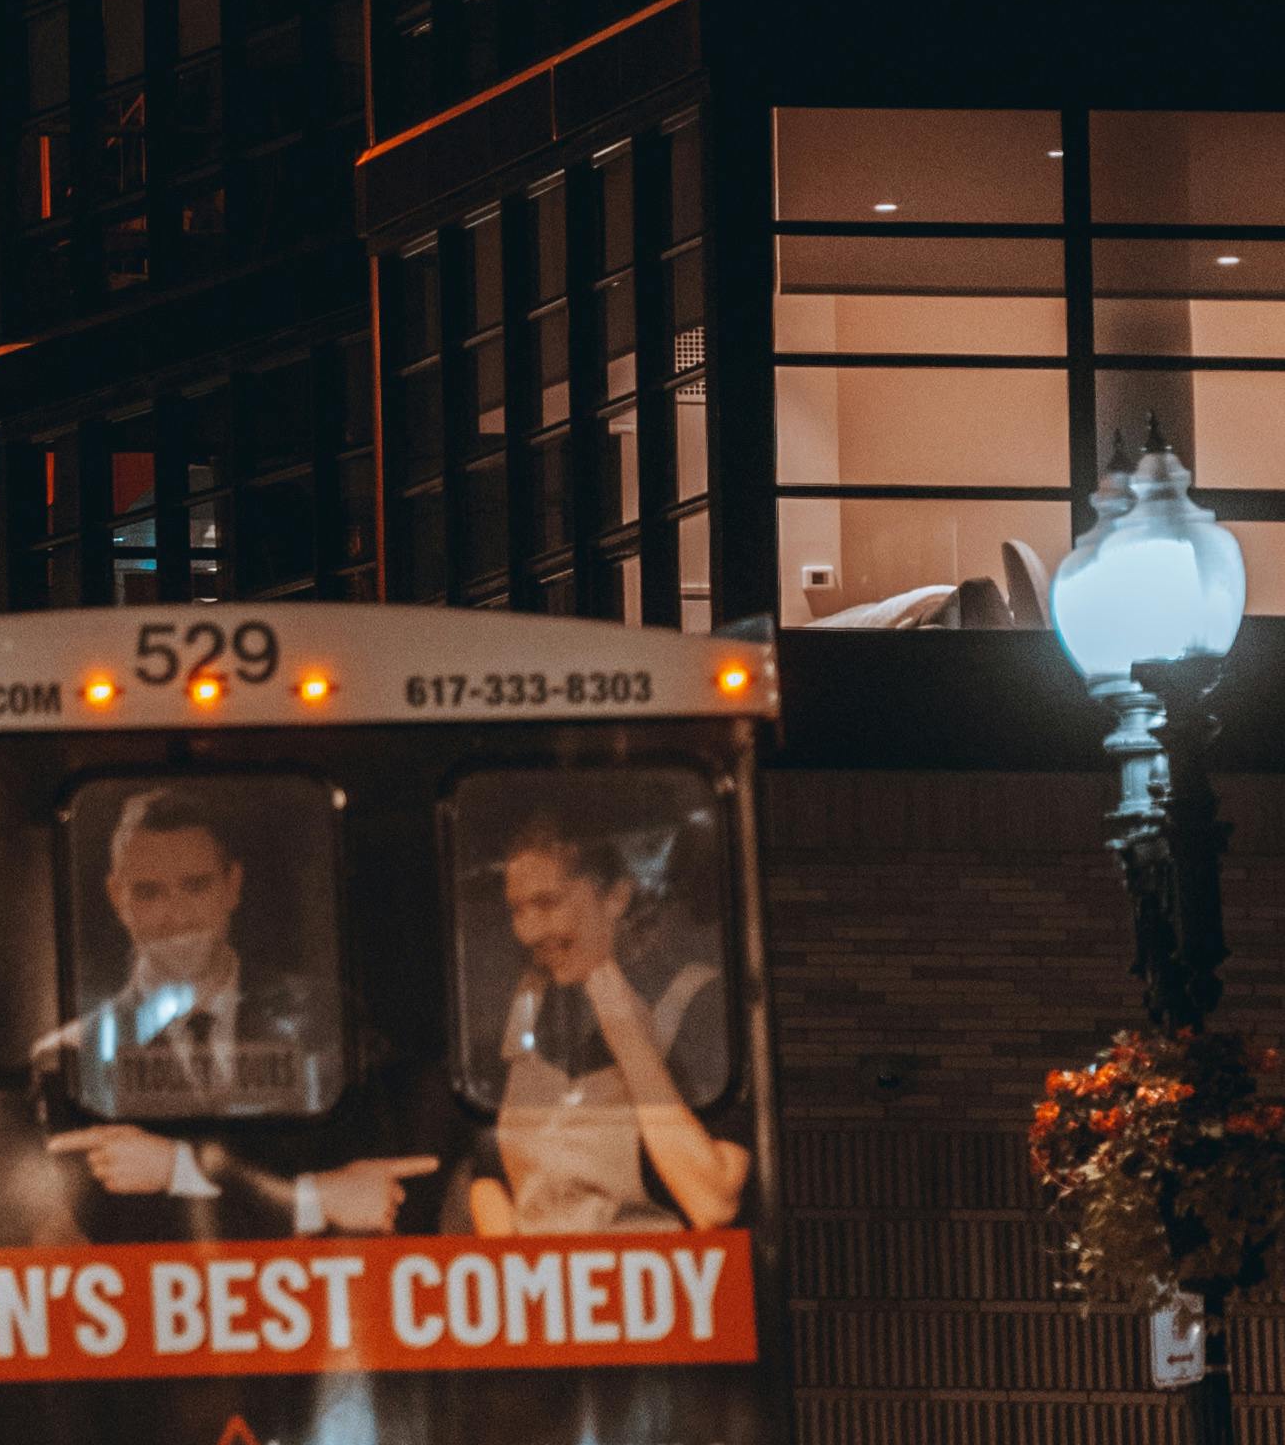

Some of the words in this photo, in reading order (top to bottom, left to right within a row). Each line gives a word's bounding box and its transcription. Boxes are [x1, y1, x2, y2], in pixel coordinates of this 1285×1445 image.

[136, 620, 280, 686] 529
[405, 671, 652, 707] 617-333-8303
[151, 1257, 365, 1355] BEST
[390, 1248, 726, 1349] COMEDY
